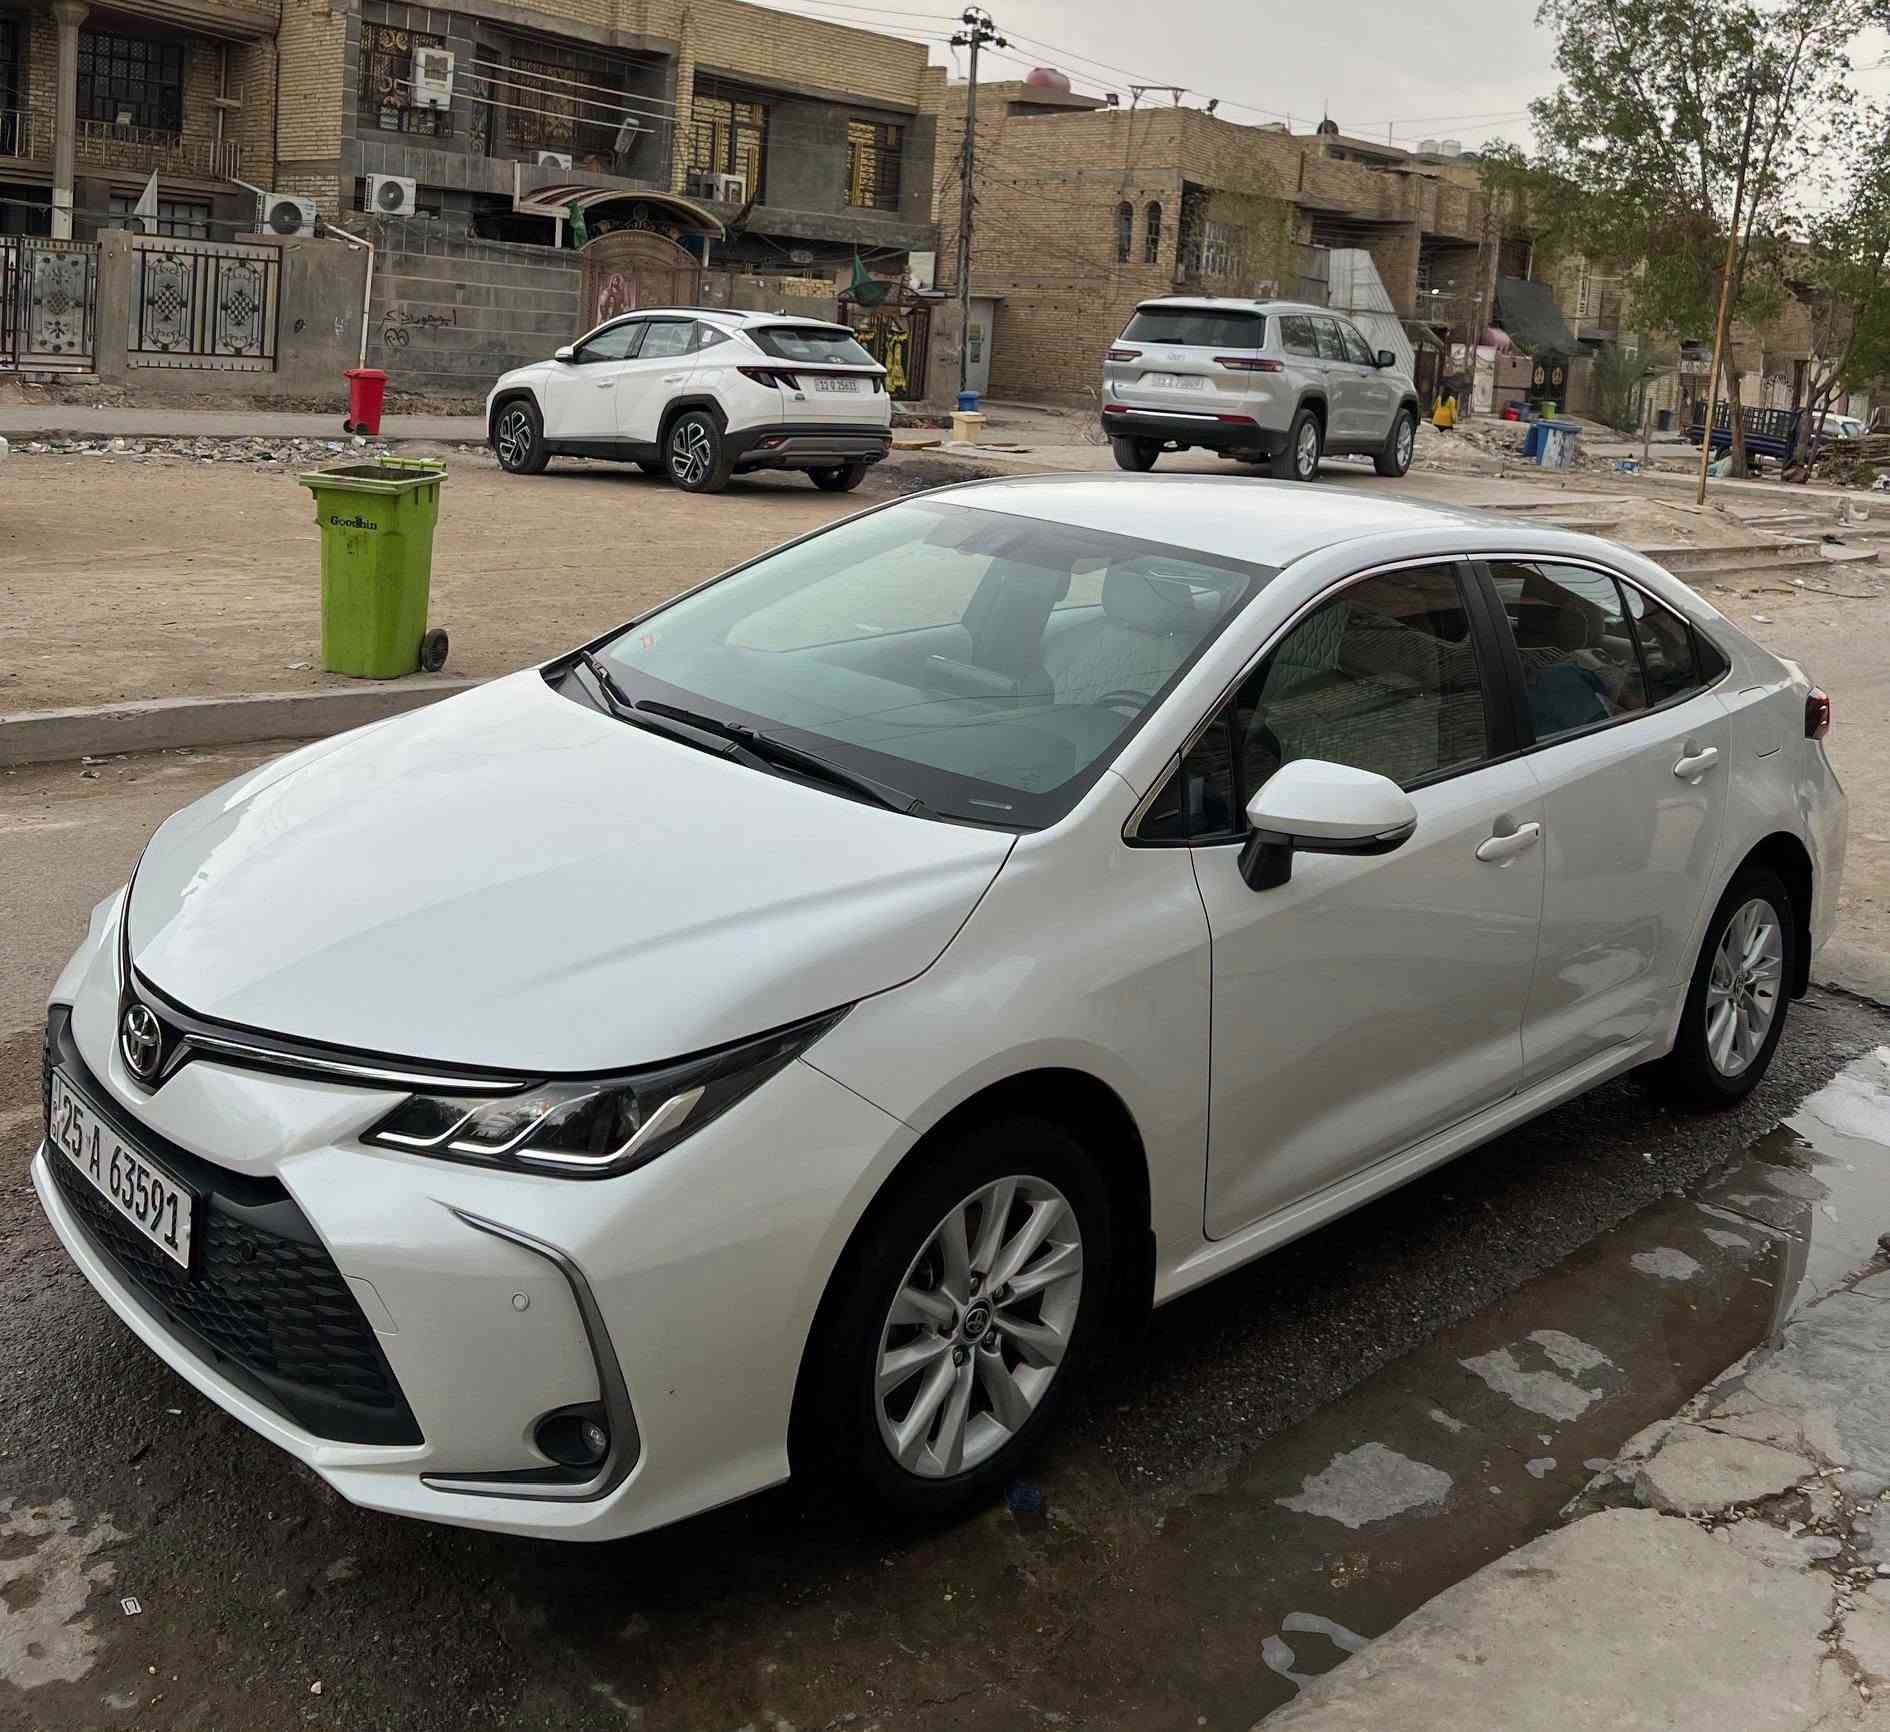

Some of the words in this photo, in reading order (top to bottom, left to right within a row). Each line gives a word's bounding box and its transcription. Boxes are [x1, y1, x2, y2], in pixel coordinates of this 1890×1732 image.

[61, 1095, 83, 1158] 25
[89, 1125, 101, 1181] A
[110, 1146, 179, 1251] 63591
